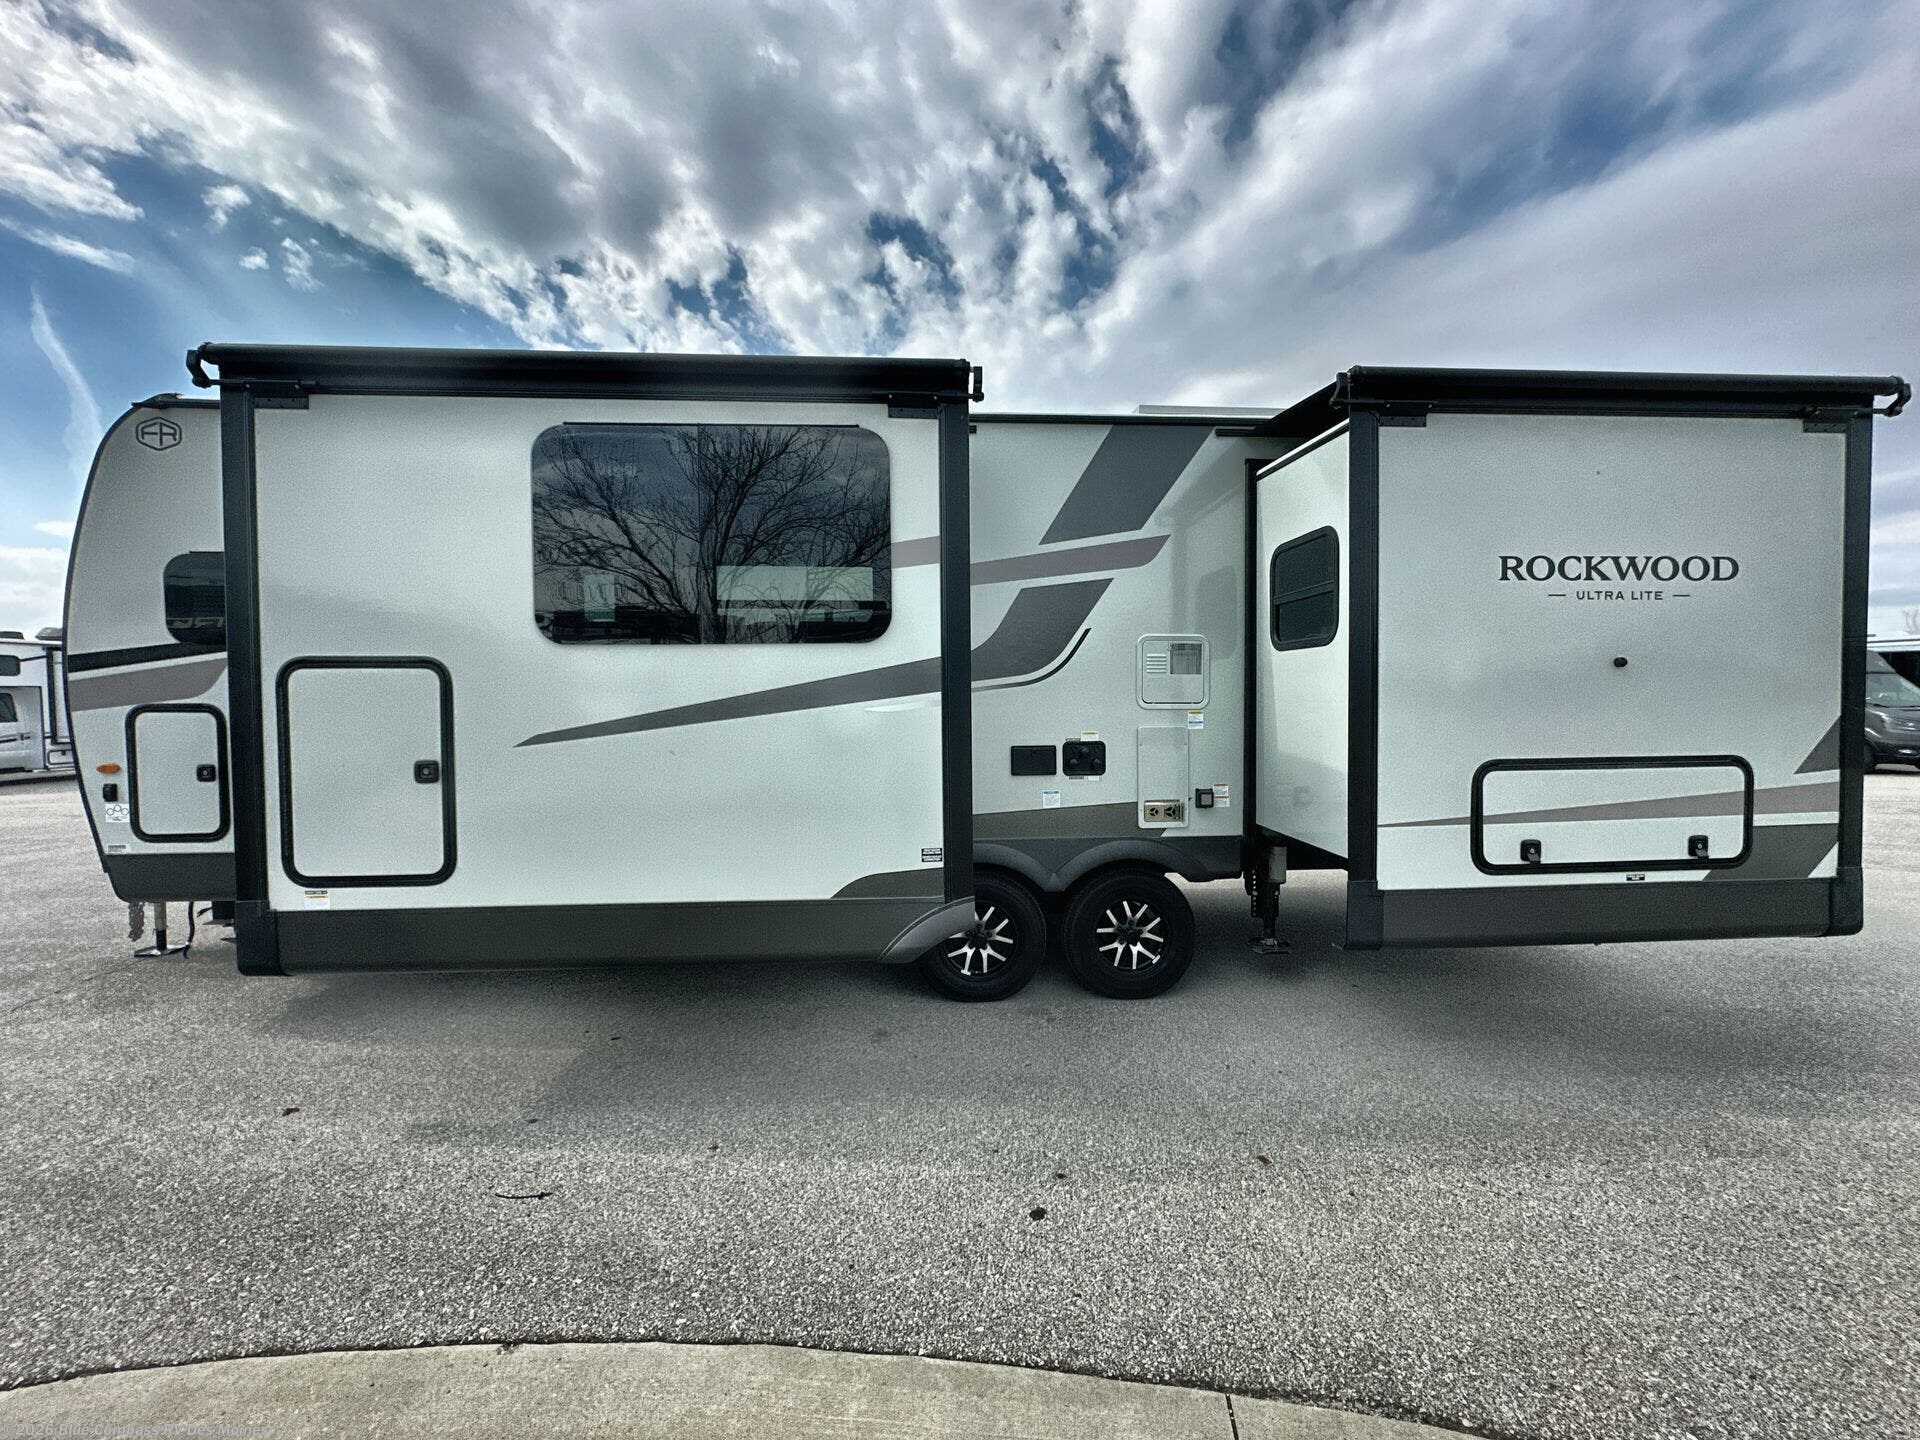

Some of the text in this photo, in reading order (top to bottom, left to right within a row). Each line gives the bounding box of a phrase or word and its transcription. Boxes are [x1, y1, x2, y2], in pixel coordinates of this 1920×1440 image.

[1498, 555, 1739, 581] ROCKWOOD
[1576, 591, 1663, 600] ULTRA LITE
